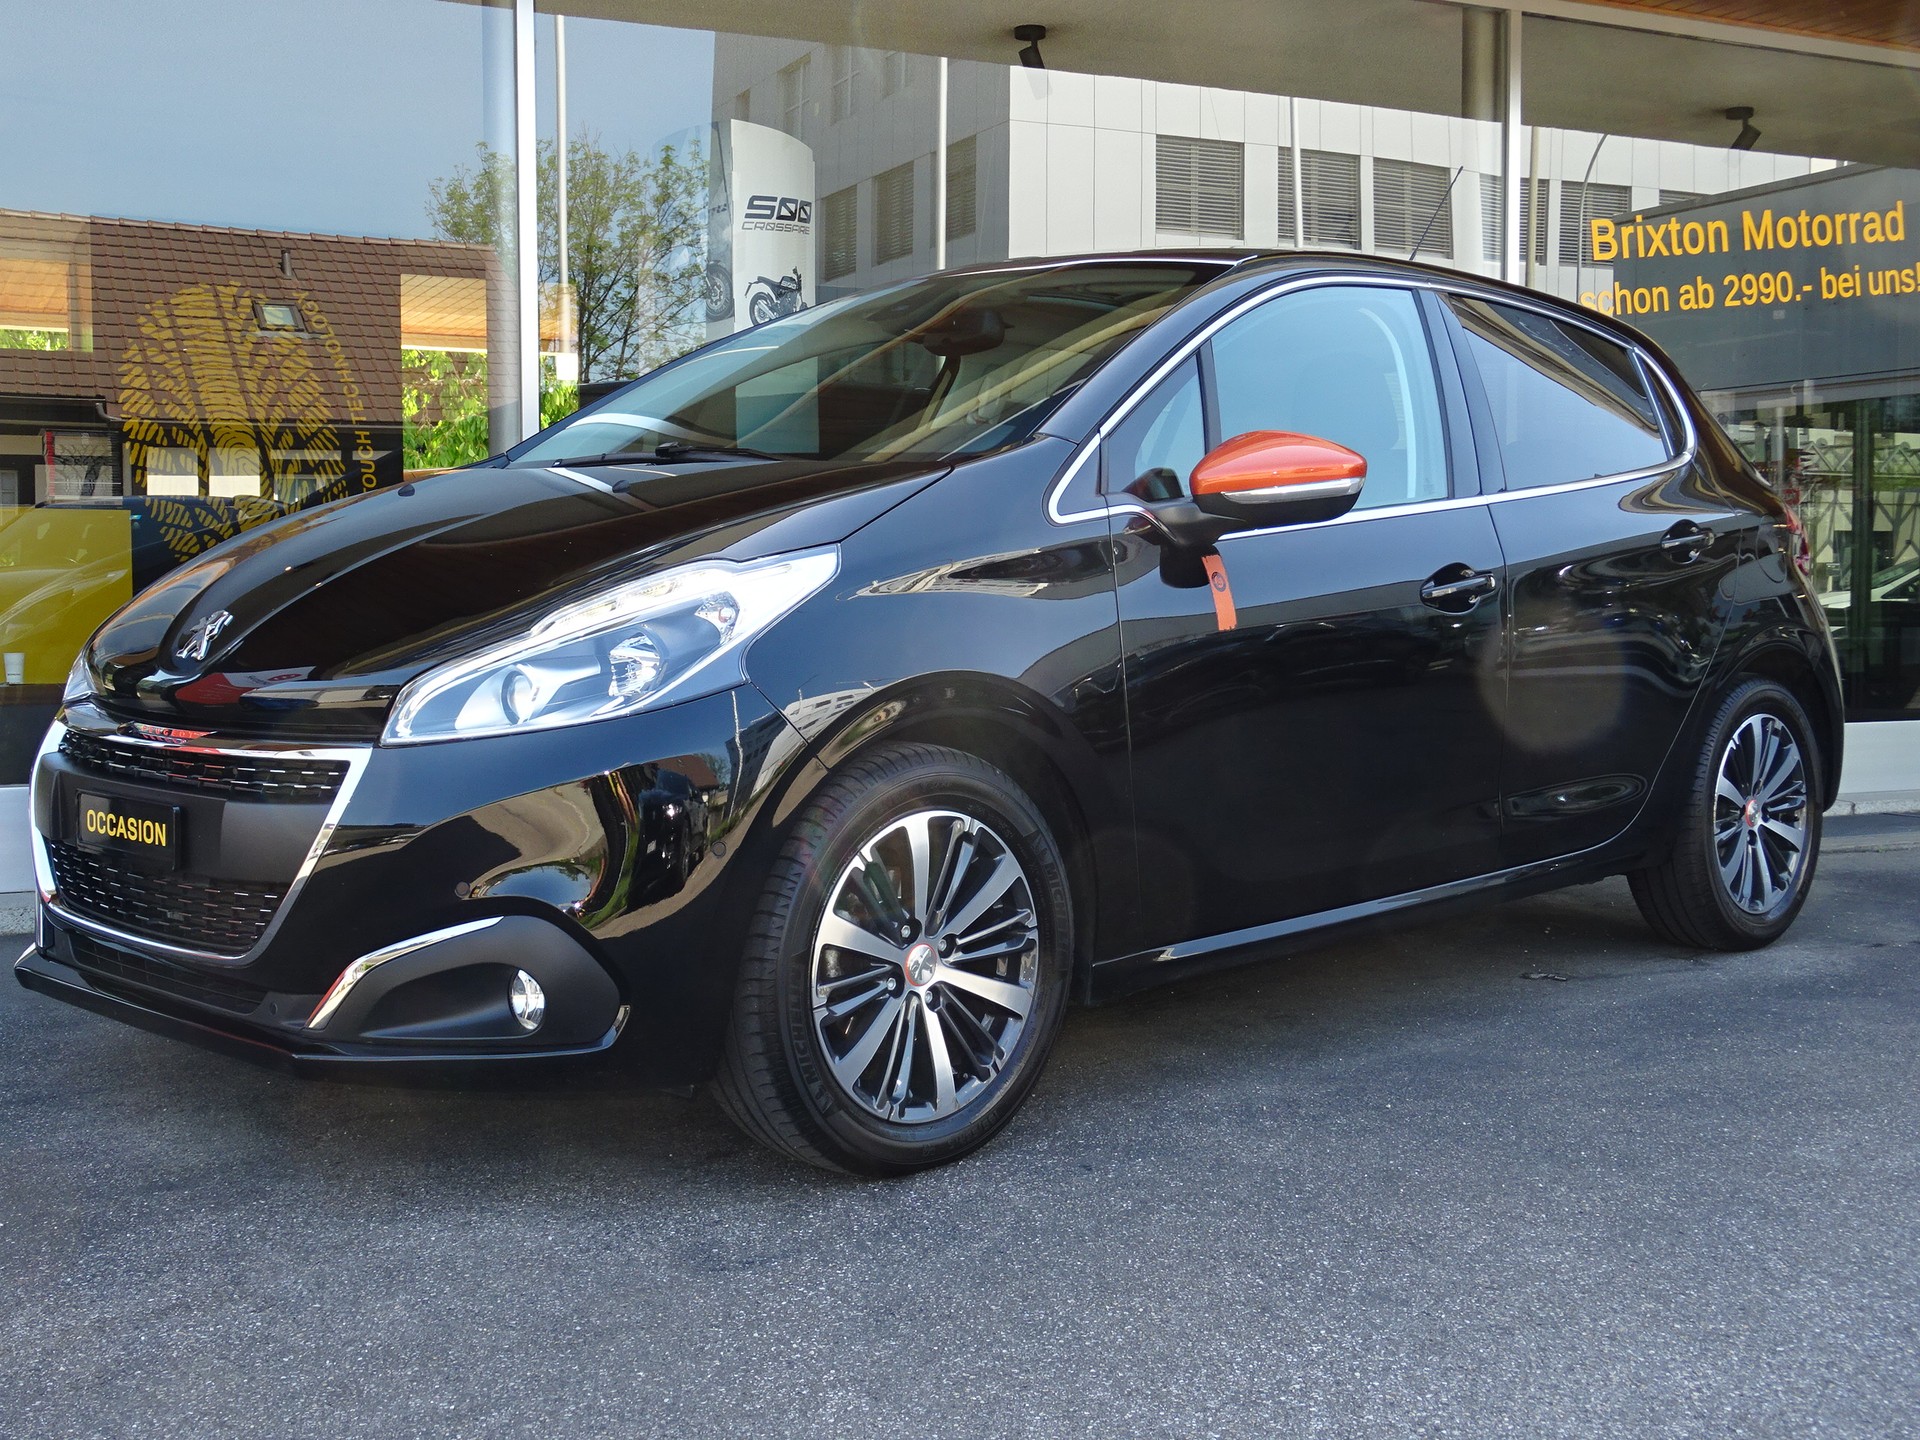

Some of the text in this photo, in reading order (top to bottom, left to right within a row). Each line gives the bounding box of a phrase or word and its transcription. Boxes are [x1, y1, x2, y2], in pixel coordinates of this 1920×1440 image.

[1590, 200, 1906, 261] Brixton Motorrad
[1579, 281, 1670, 317] schon
[1678, 275, 1715, 310] ab
[1722, 270, 1813, 307] 2990.-
[1820, 264, 1862, 299] bei
[292, 292, 377, 493] OUCH TECHNOLOGY
[86, 809, 166, 847] OCCASION
